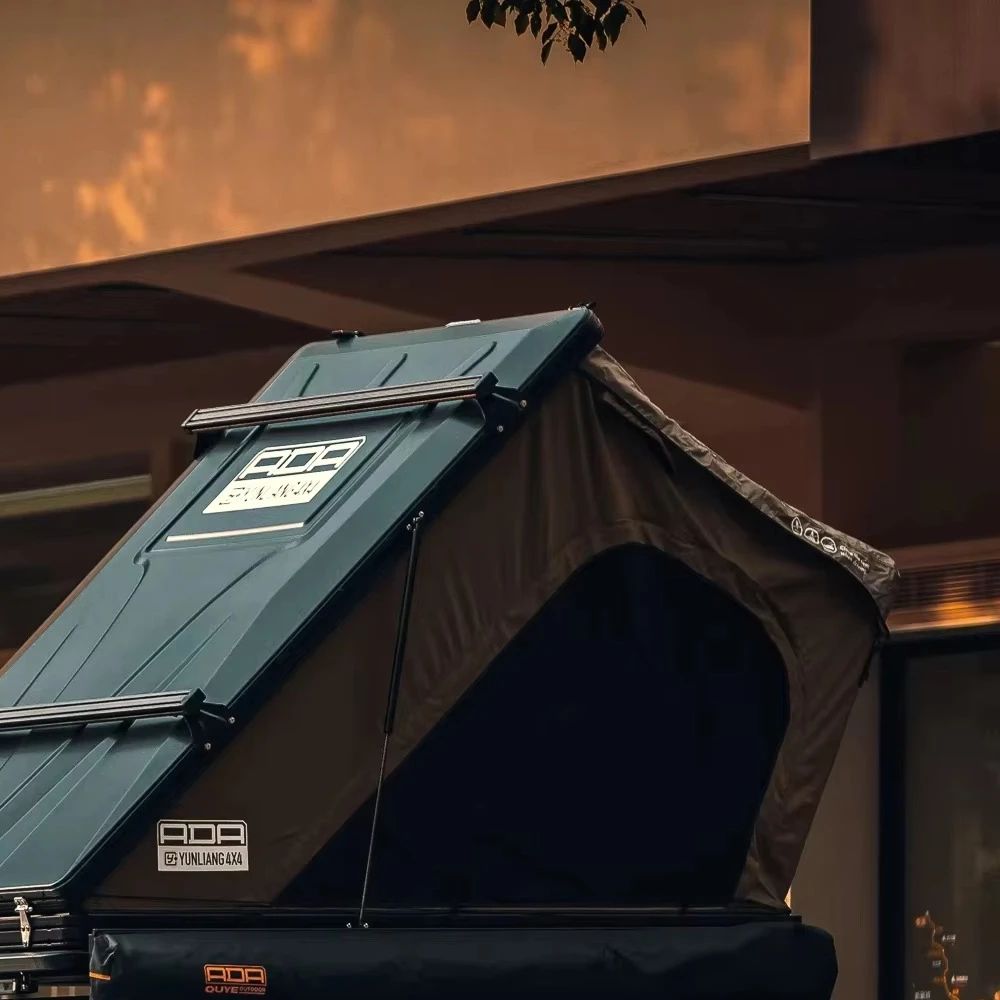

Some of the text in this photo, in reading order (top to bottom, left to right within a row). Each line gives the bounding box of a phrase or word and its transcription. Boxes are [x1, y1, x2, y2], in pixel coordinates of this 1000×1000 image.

[238, 440, 362, 480] ADA
[159, 823, 246, 845] ADA
[179, 852, 224, 866] YUNLIANG
[207, 966, 265, 984] ADA
